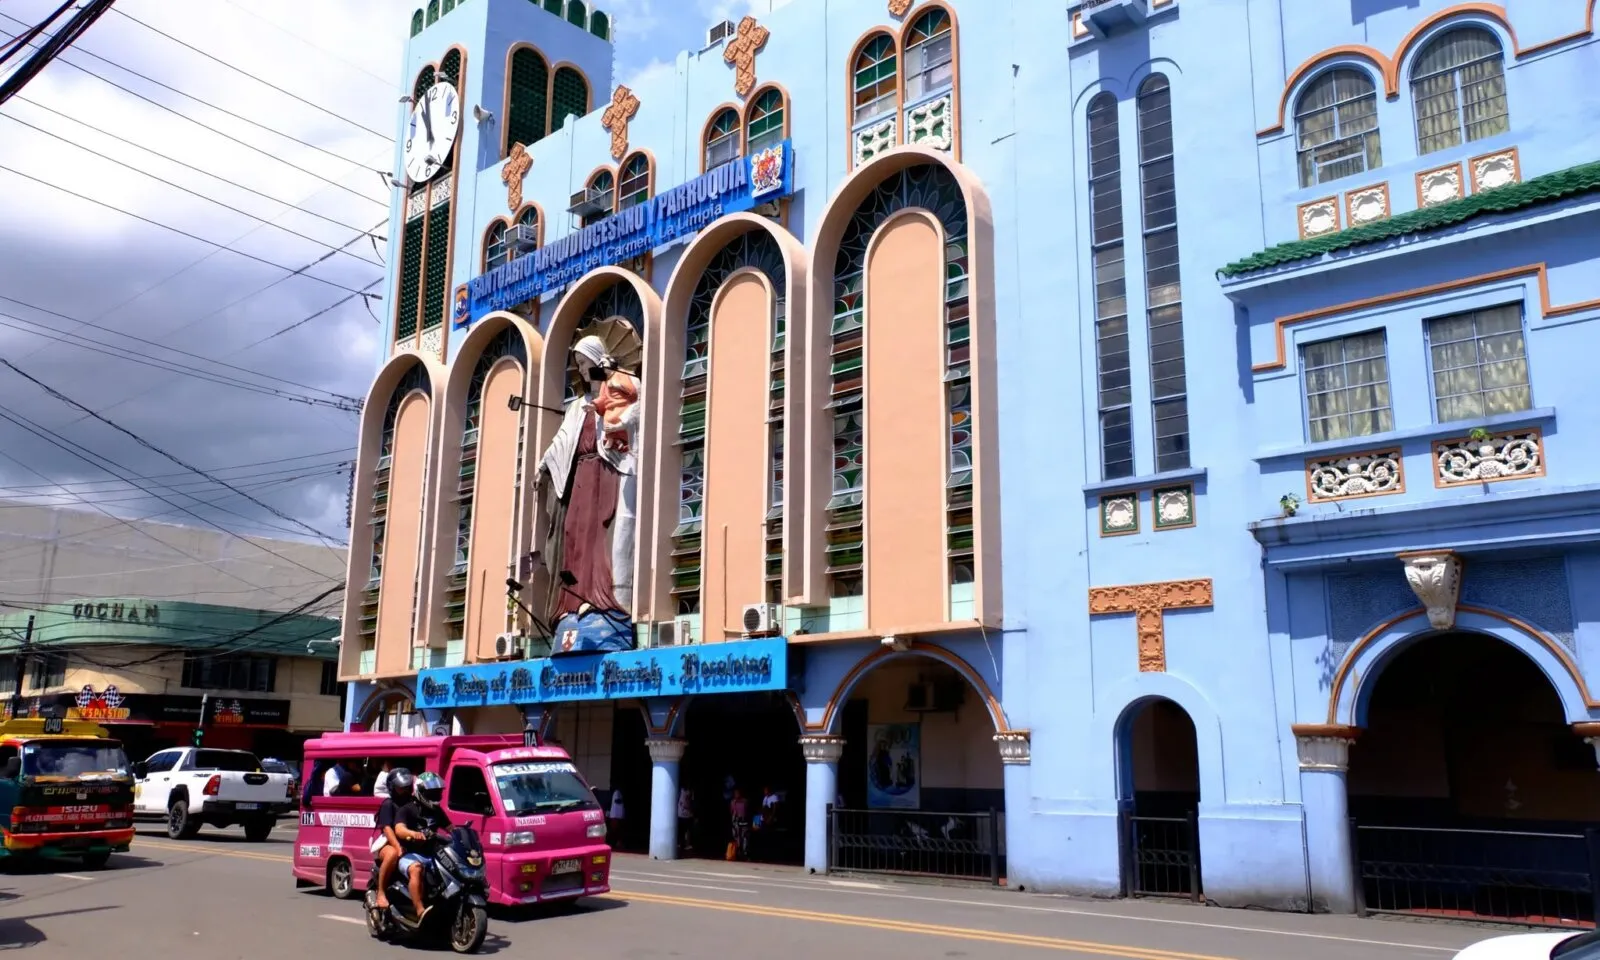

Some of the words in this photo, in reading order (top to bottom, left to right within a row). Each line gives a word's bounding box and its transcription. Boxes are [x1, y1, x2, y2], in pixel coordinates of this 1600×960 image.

[452, 110, 458, 124] 3
[406, 139, 412, 153] 9
[425, 166, 431, 178] 6
[472, 254, 532, 300] SANTUARIO
[534, 203, 644, 273] ARQUIDIOCESANO
[647, 197, 657, 224] Y
[659, 161, 747, 219] PARROQUIA
[504, 281, 542, 306] Nuestra
[545, 261, 582, 286] Señora
[585, 248, 601, 268] del
[659, 222, 675, 239] La
[678, 202, 722, 230] Limpia
[74, 603, 160, 622] GOCHAN
[421, 675, 449, 697] Our
[452, 672, 487, 696] Lady
[491, 670, 506, 690] of
[540, 664, 596, 689] Carmel
[602, 656, 662, 688] Parish
[681, 652, 772, 680] Recoletos
[61, 804, 98, 813] ISUZU
[350, 815, 371, 827] COLON
